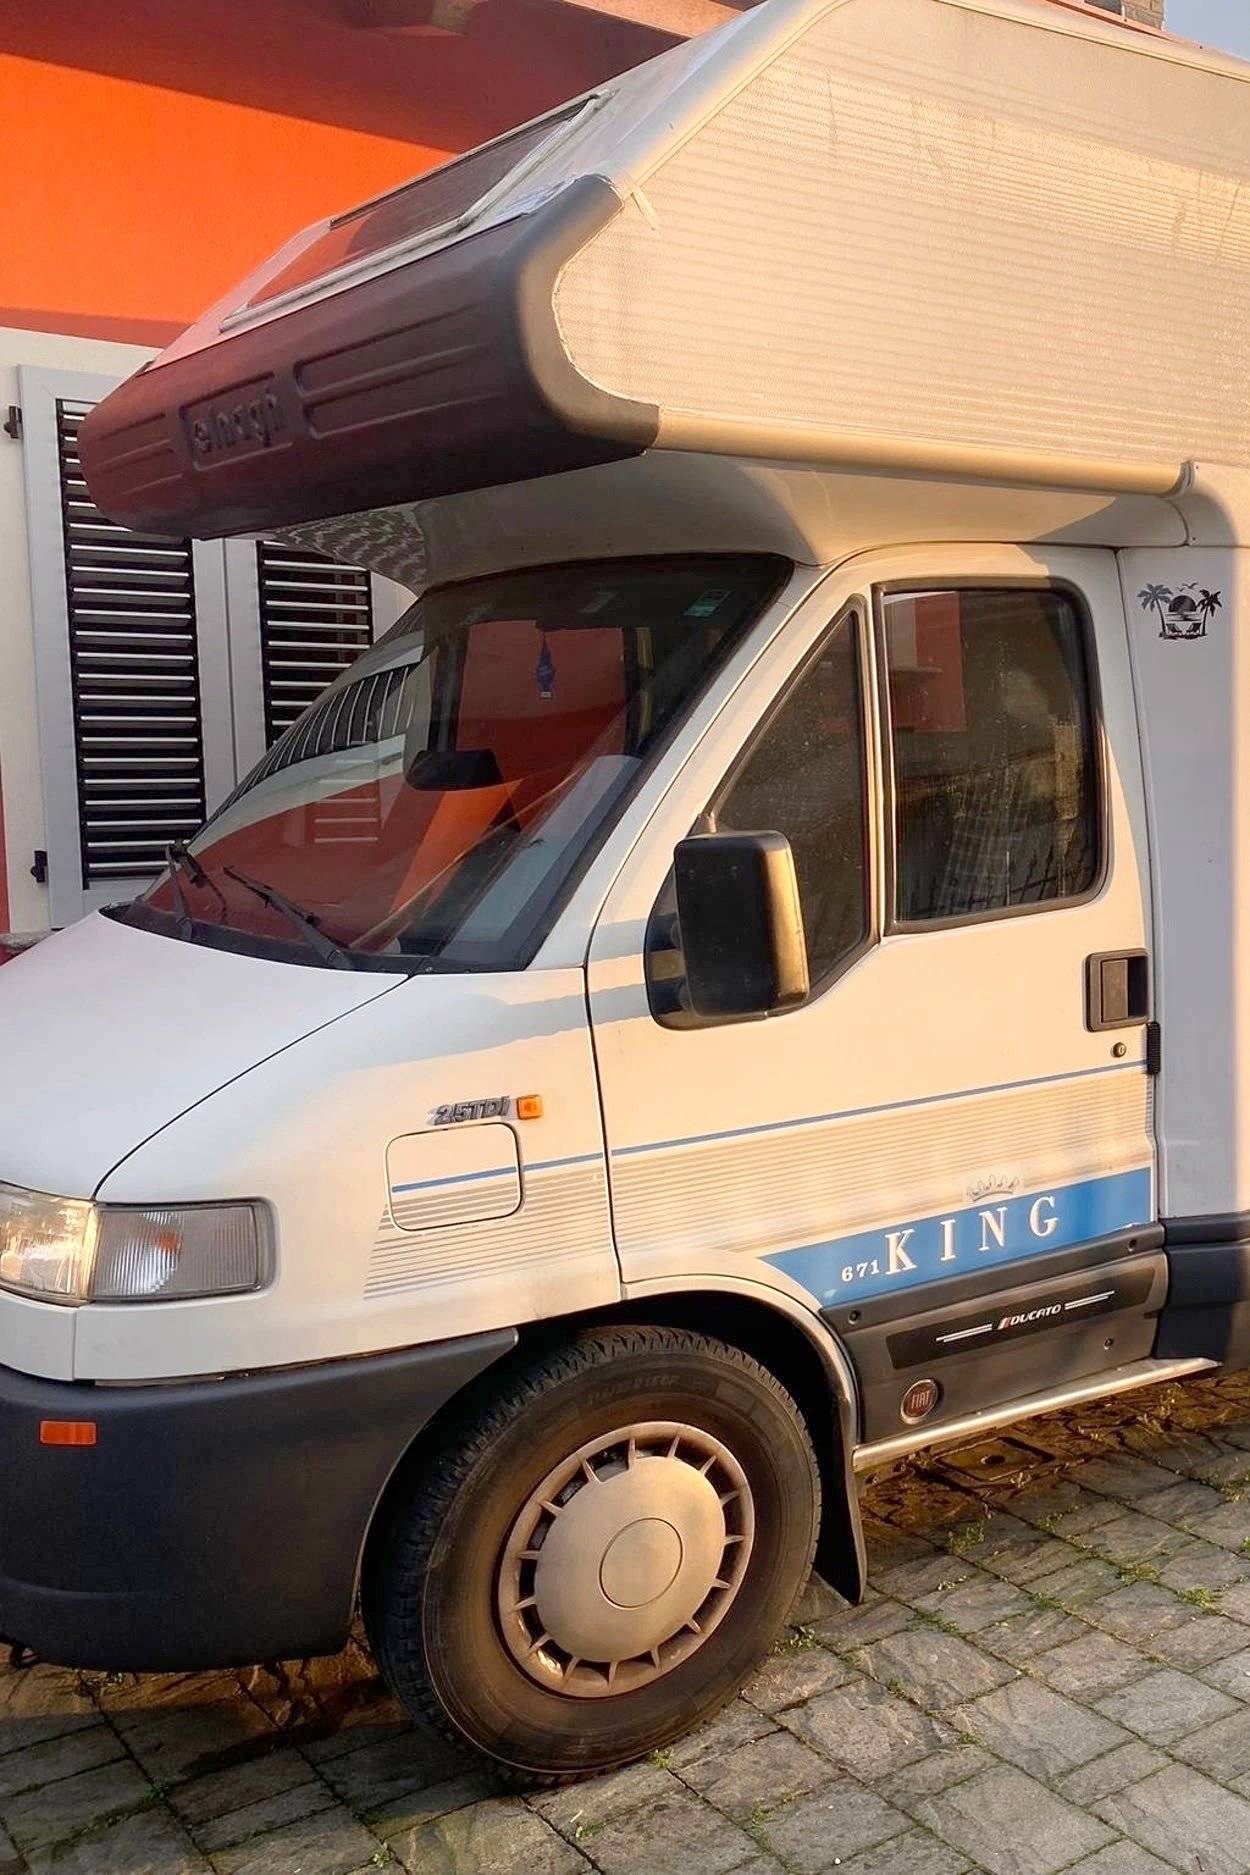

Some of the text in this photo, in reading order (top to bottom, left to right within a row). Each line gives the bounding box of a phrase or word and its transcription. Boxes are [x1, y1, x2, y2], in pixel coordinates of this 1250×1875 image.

[841, 1196, 1059, 1282] 671 KING
[1008, 1304, 1062, 1327] DUCATO
[911, 1390, 931, 1409] FIAT
